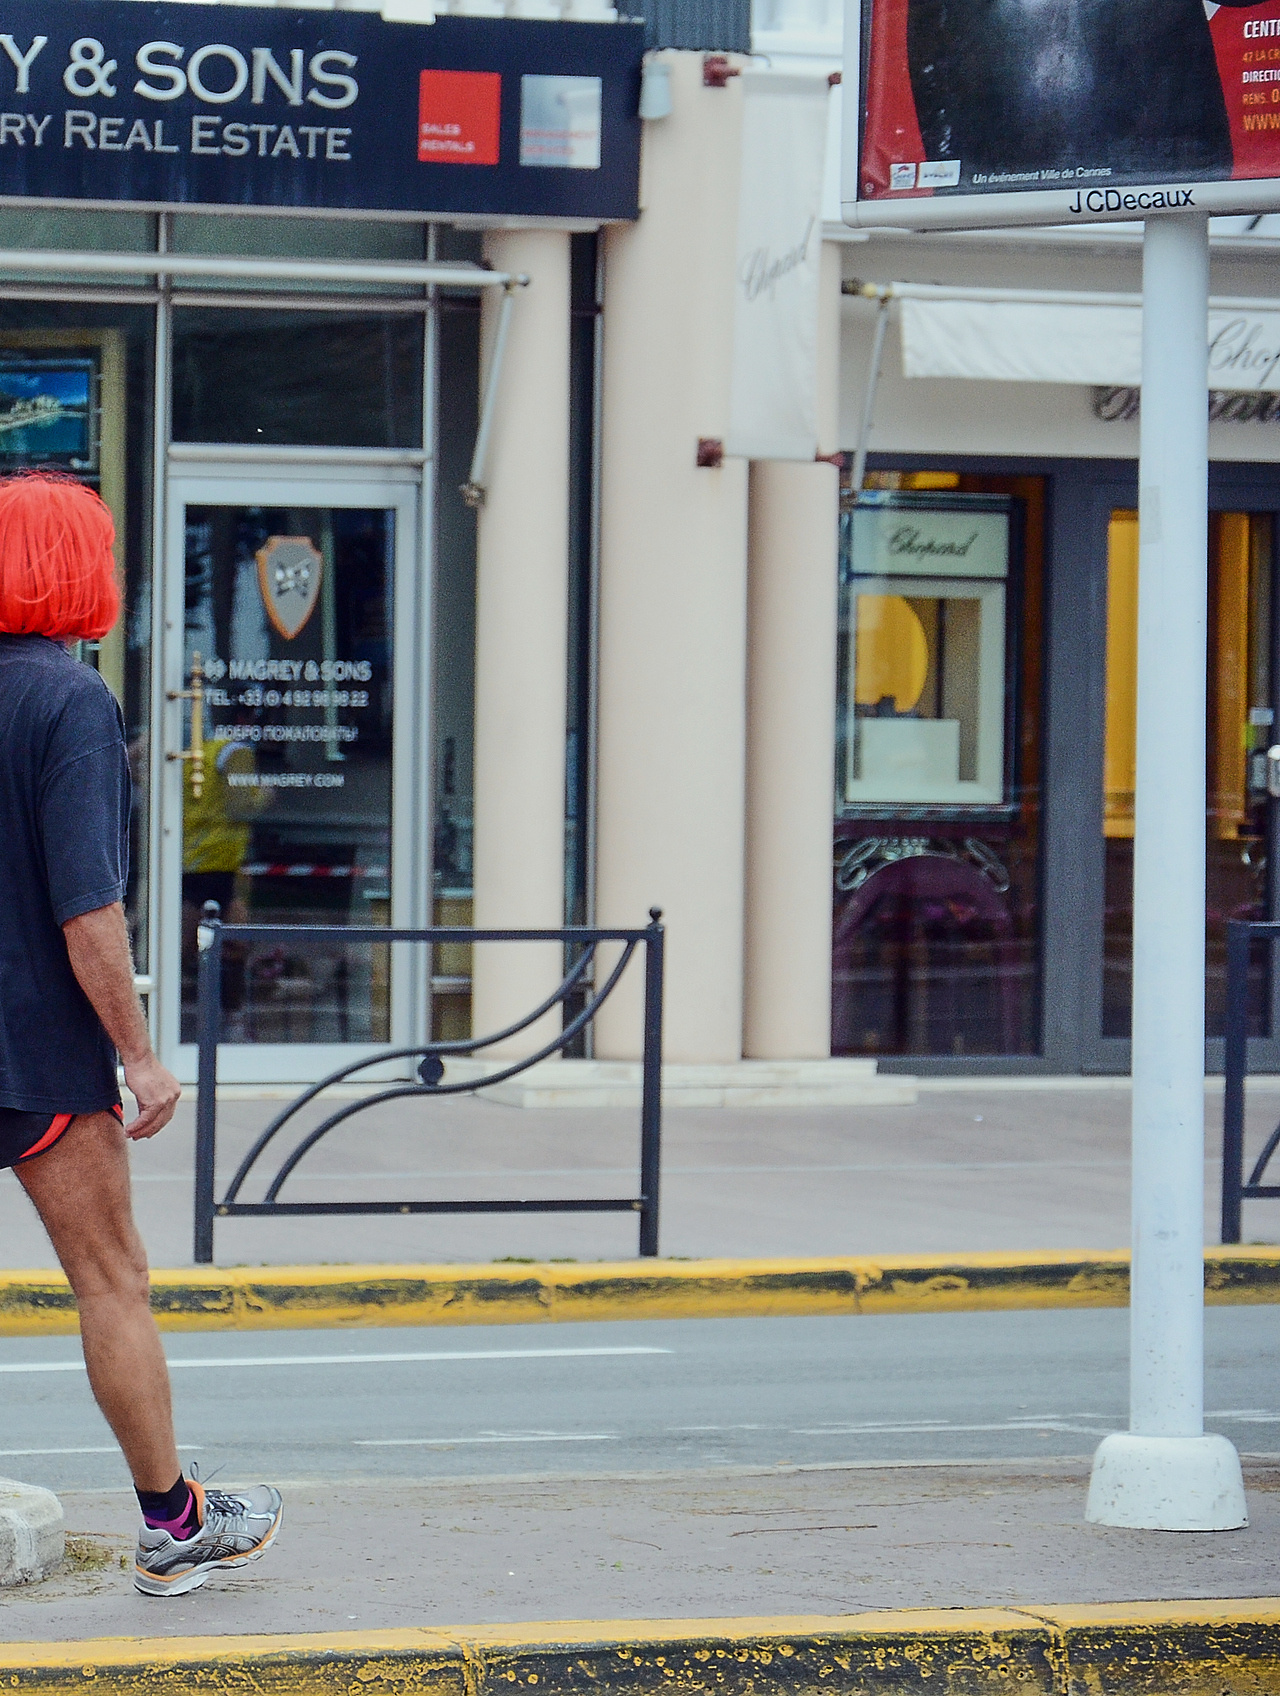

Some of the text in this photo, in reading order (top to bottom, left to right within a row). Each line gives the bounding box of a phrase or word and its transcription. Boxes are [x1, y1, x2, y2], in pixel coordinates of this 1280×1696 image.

[63, 37, 118, 97] &
[133, 40, 359, 110] SONS
[421, 122, 462, 136] SALES
[420, 139, 476, 154] RENTALS
[972, 173, 987, 184] Un
[1041, 168, 1061, 180] Ville
[1061, 168, 1075, 179] de
[1075, 166, 1112, 178] Cannes
[1069, 188, 1196, 213] JCDecaux
[229, 659, 372, 682] MAGREY & SONS
[349, 690, 369, 707] 22
